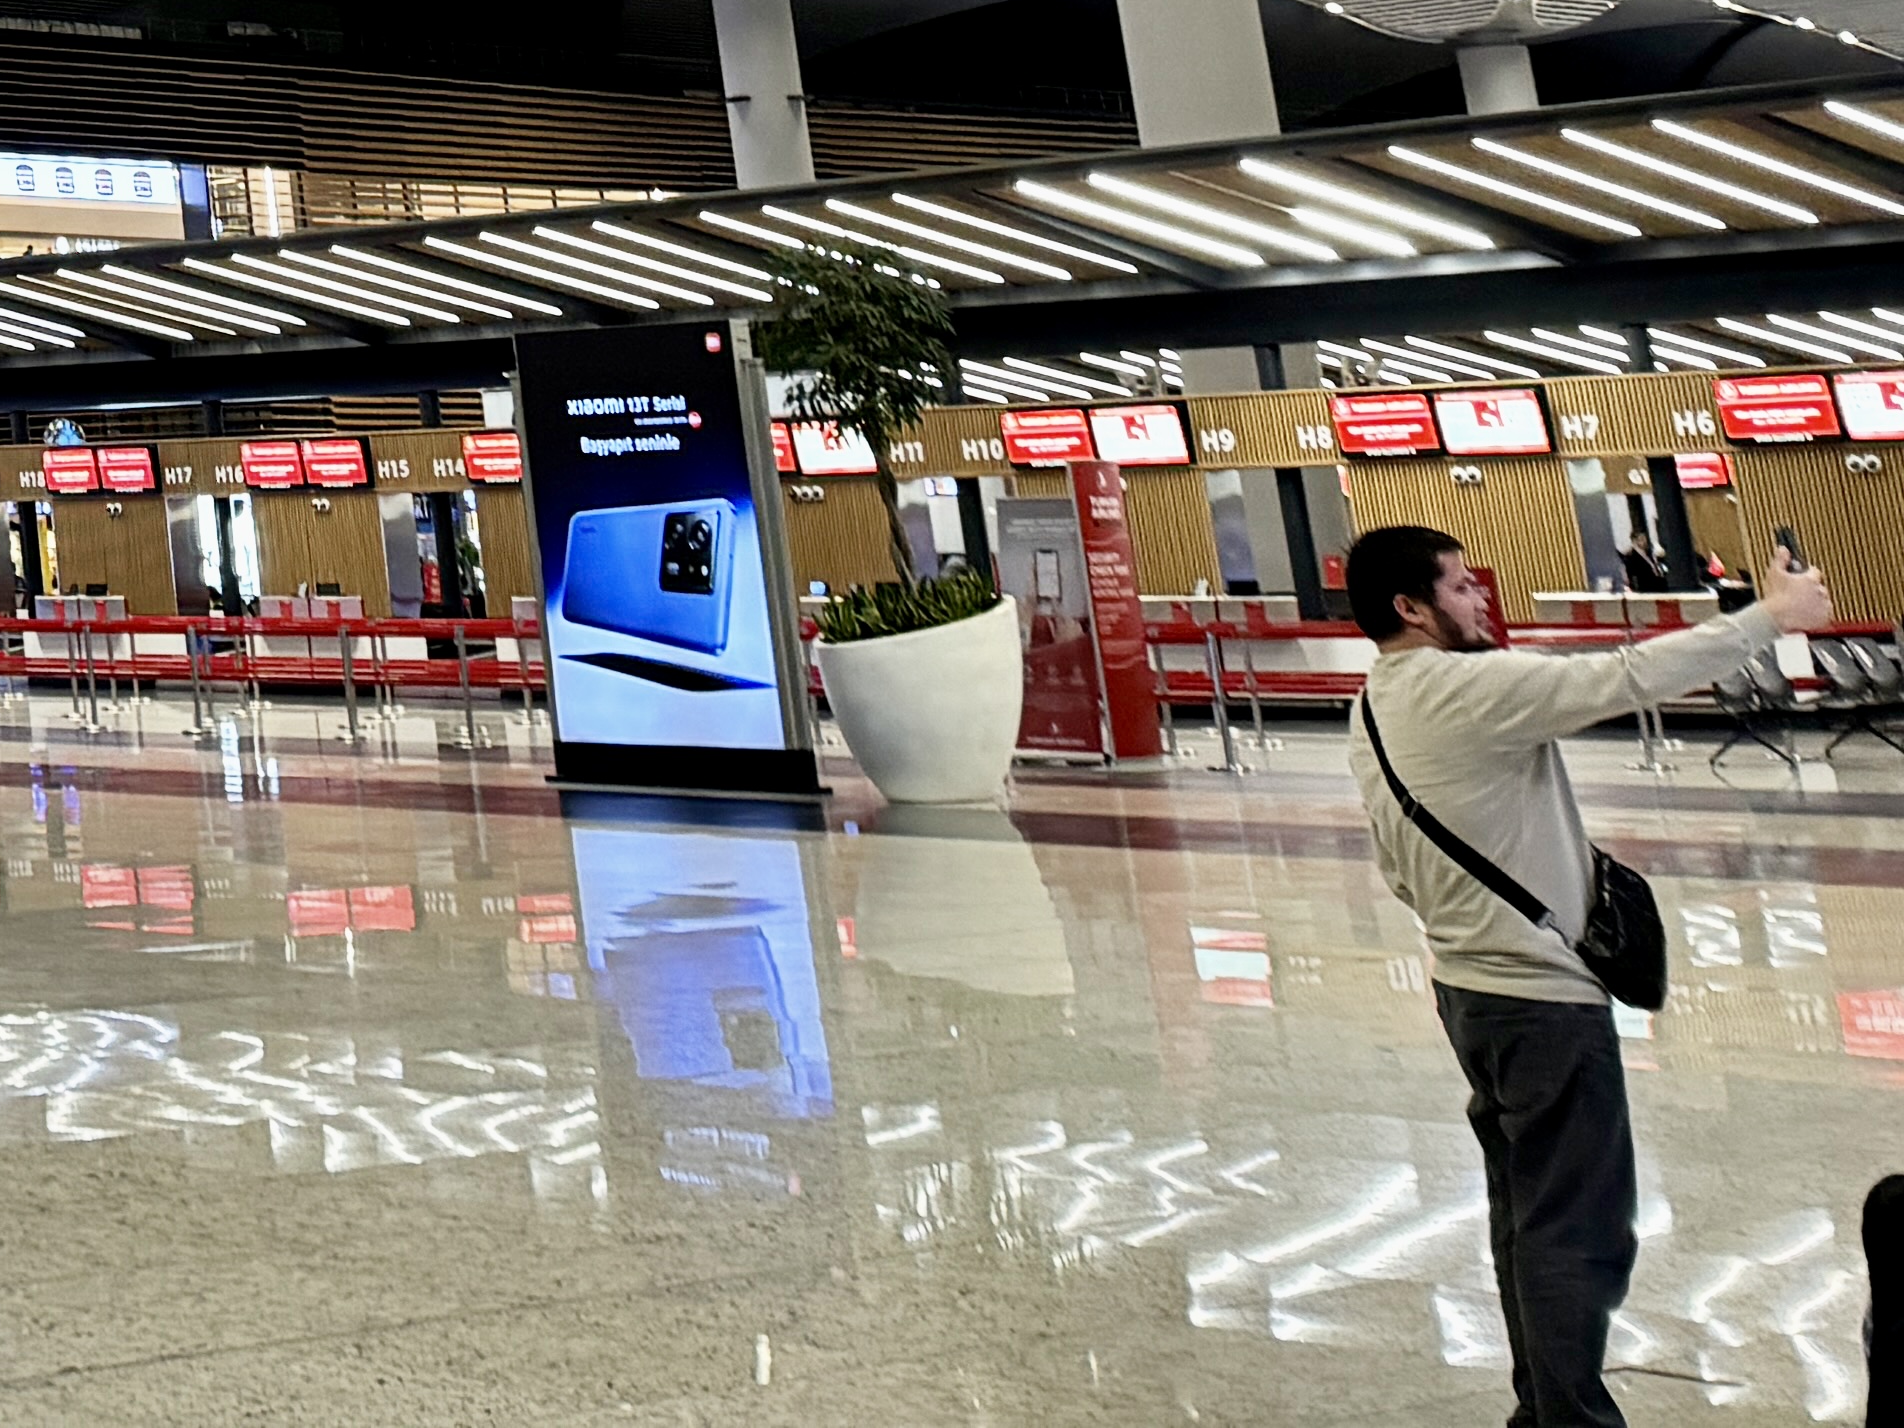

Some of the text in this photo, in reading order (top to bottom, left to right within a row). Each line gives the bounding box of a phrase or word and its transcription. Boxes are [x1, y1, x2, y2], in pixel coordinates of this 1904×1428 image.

[626, 396, 650, 414] 13T
[1560, 412, 1601, 442] H7
[1671, 407, 1717, 437] H6
[1200, 428, 1236, 453] H9
[1295, 424, 1334, 450] H8
[890, 440, 925, 464] H11
[961, 436, 1004, 461] H10
[19, 469, 46, 489] H18
[165, 465, 193, 485] H17
[215, 464, 245, 484] H16
[377, 458, 410, 479] H15
[432, 458, 466, 478] H14
